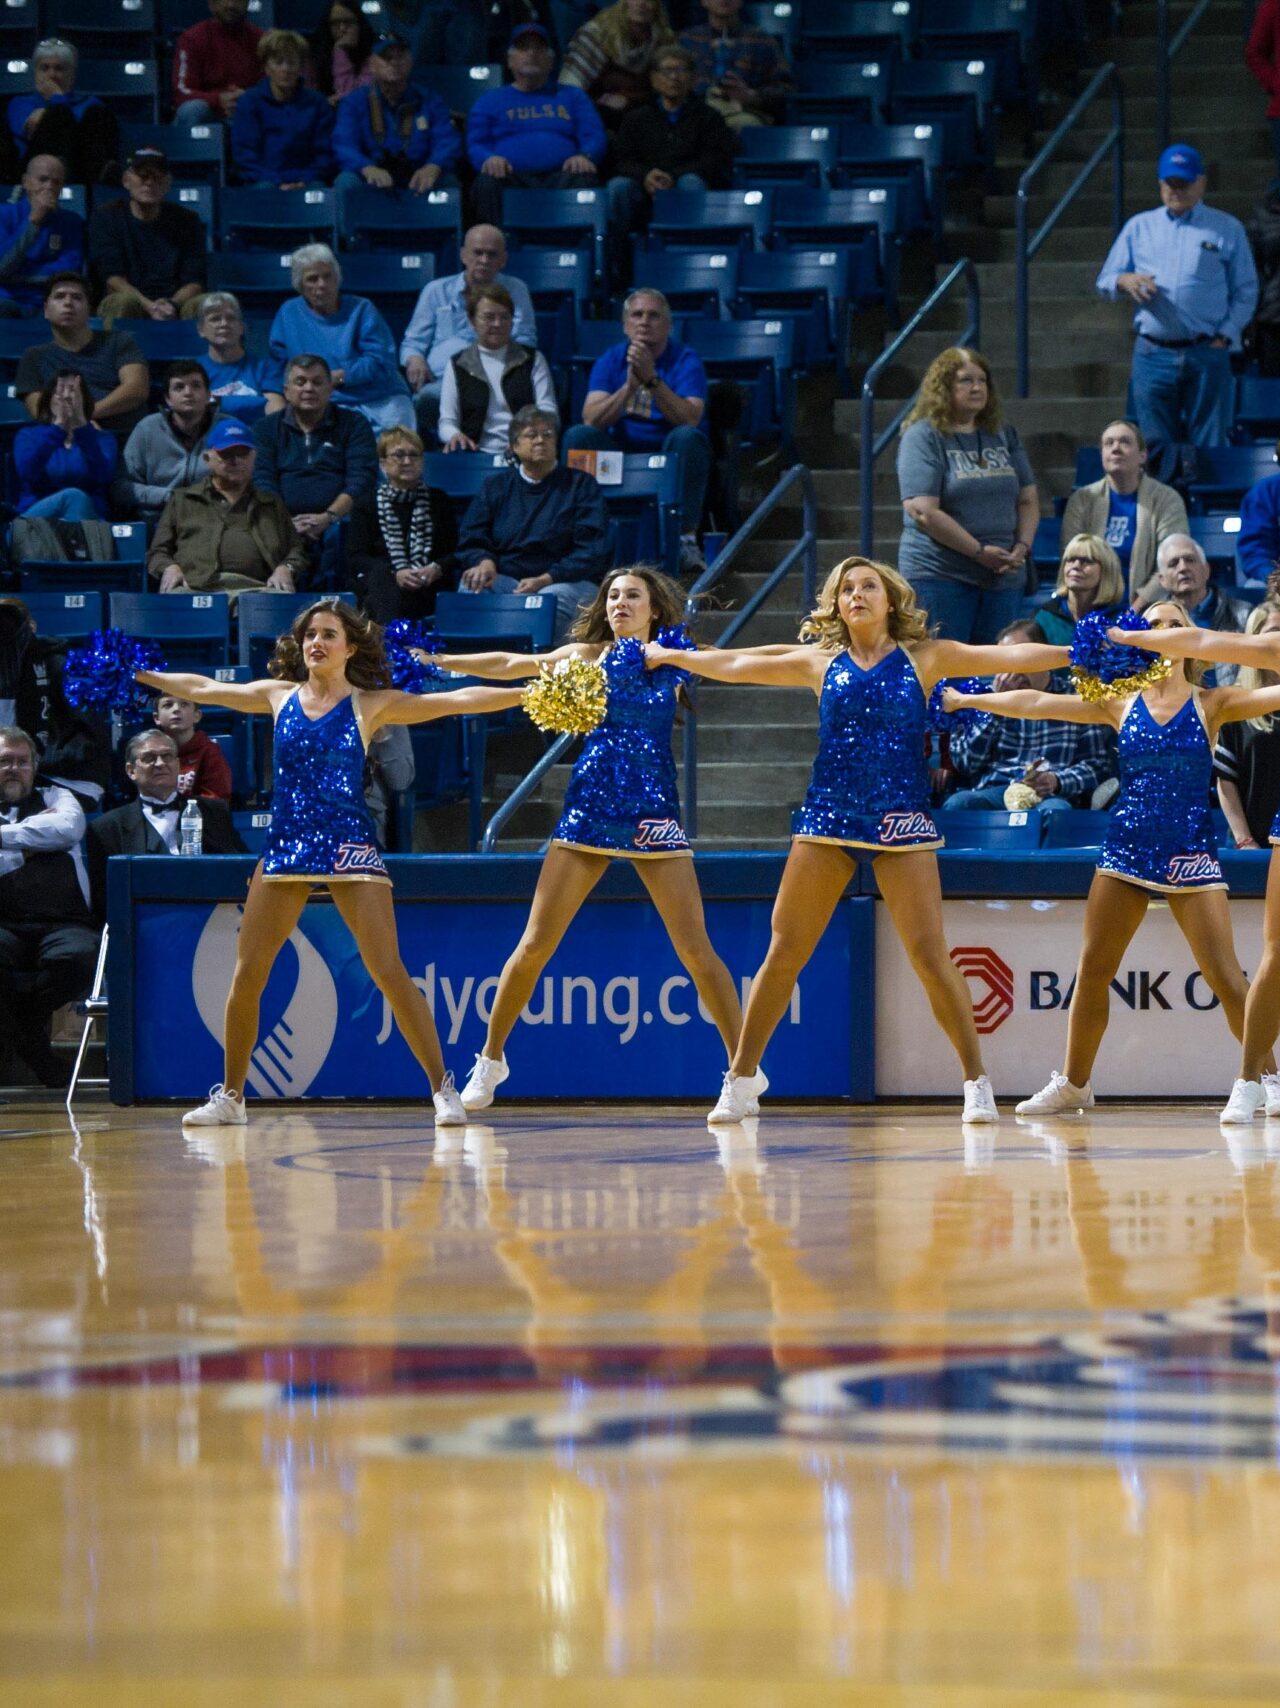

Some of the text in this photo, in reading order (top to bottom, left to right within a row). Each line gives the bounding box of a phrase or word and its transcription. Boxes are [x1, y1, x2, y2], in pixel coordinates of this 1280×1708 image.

[68, 597, 80, 607] 14
[197, 597, 209, 607] 15
[220, 670, 231, 681] 12
[256, 814, 268, 826] 10
[881, 811, 938, 842] Tulsa
[1166, 853, 1222, 884] Tulsa
